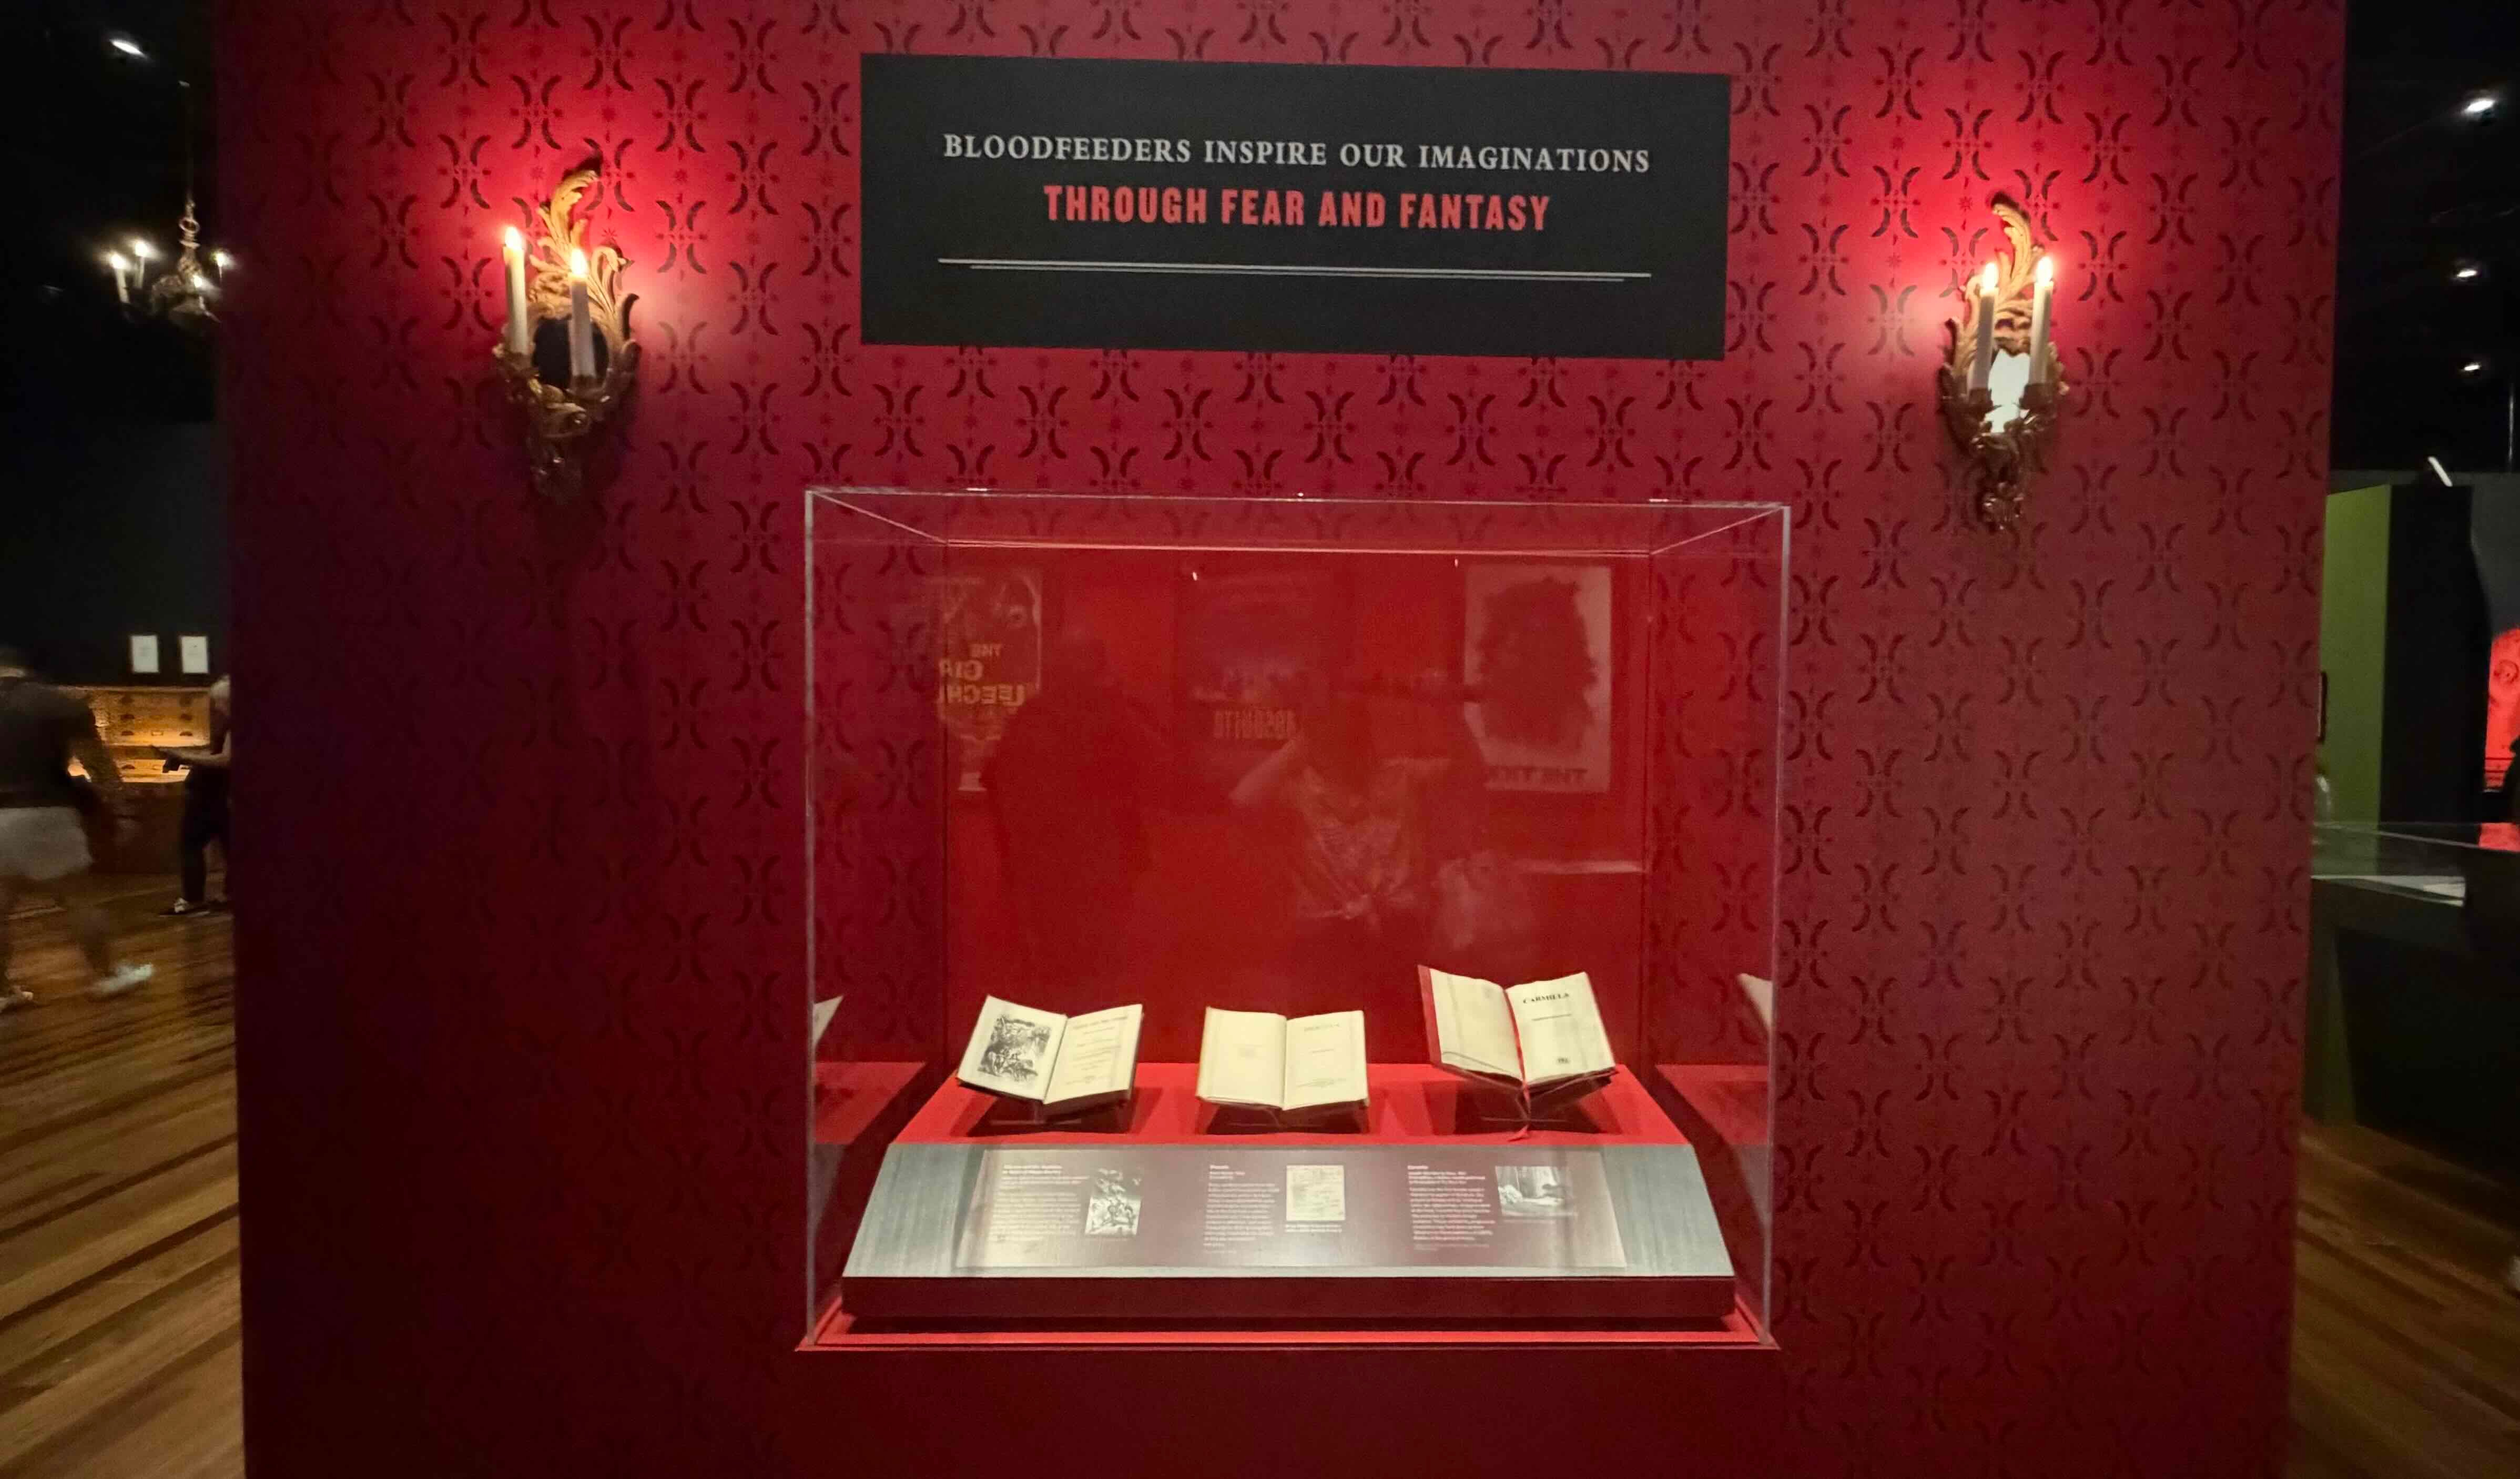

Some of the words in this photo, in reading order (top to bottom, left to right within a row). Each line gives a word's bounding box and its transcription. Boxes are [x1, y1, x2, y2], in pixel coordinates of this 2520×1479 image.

[944, 134, 1191, 164] BLOODFEEDERS
[1204, 139, 1327, 166] INSPIRE
[1339, 143, 1407, 168] OUR
[1418, 145, 1650, 174] IMAGINATIONS
[1043, 185, 1207, 224] THROUGH
[1221, 188, 1305, 226] FEAR
[1318, 191, 1386, 228] AND
[1400, 193, 1549, 231] FANTASY
